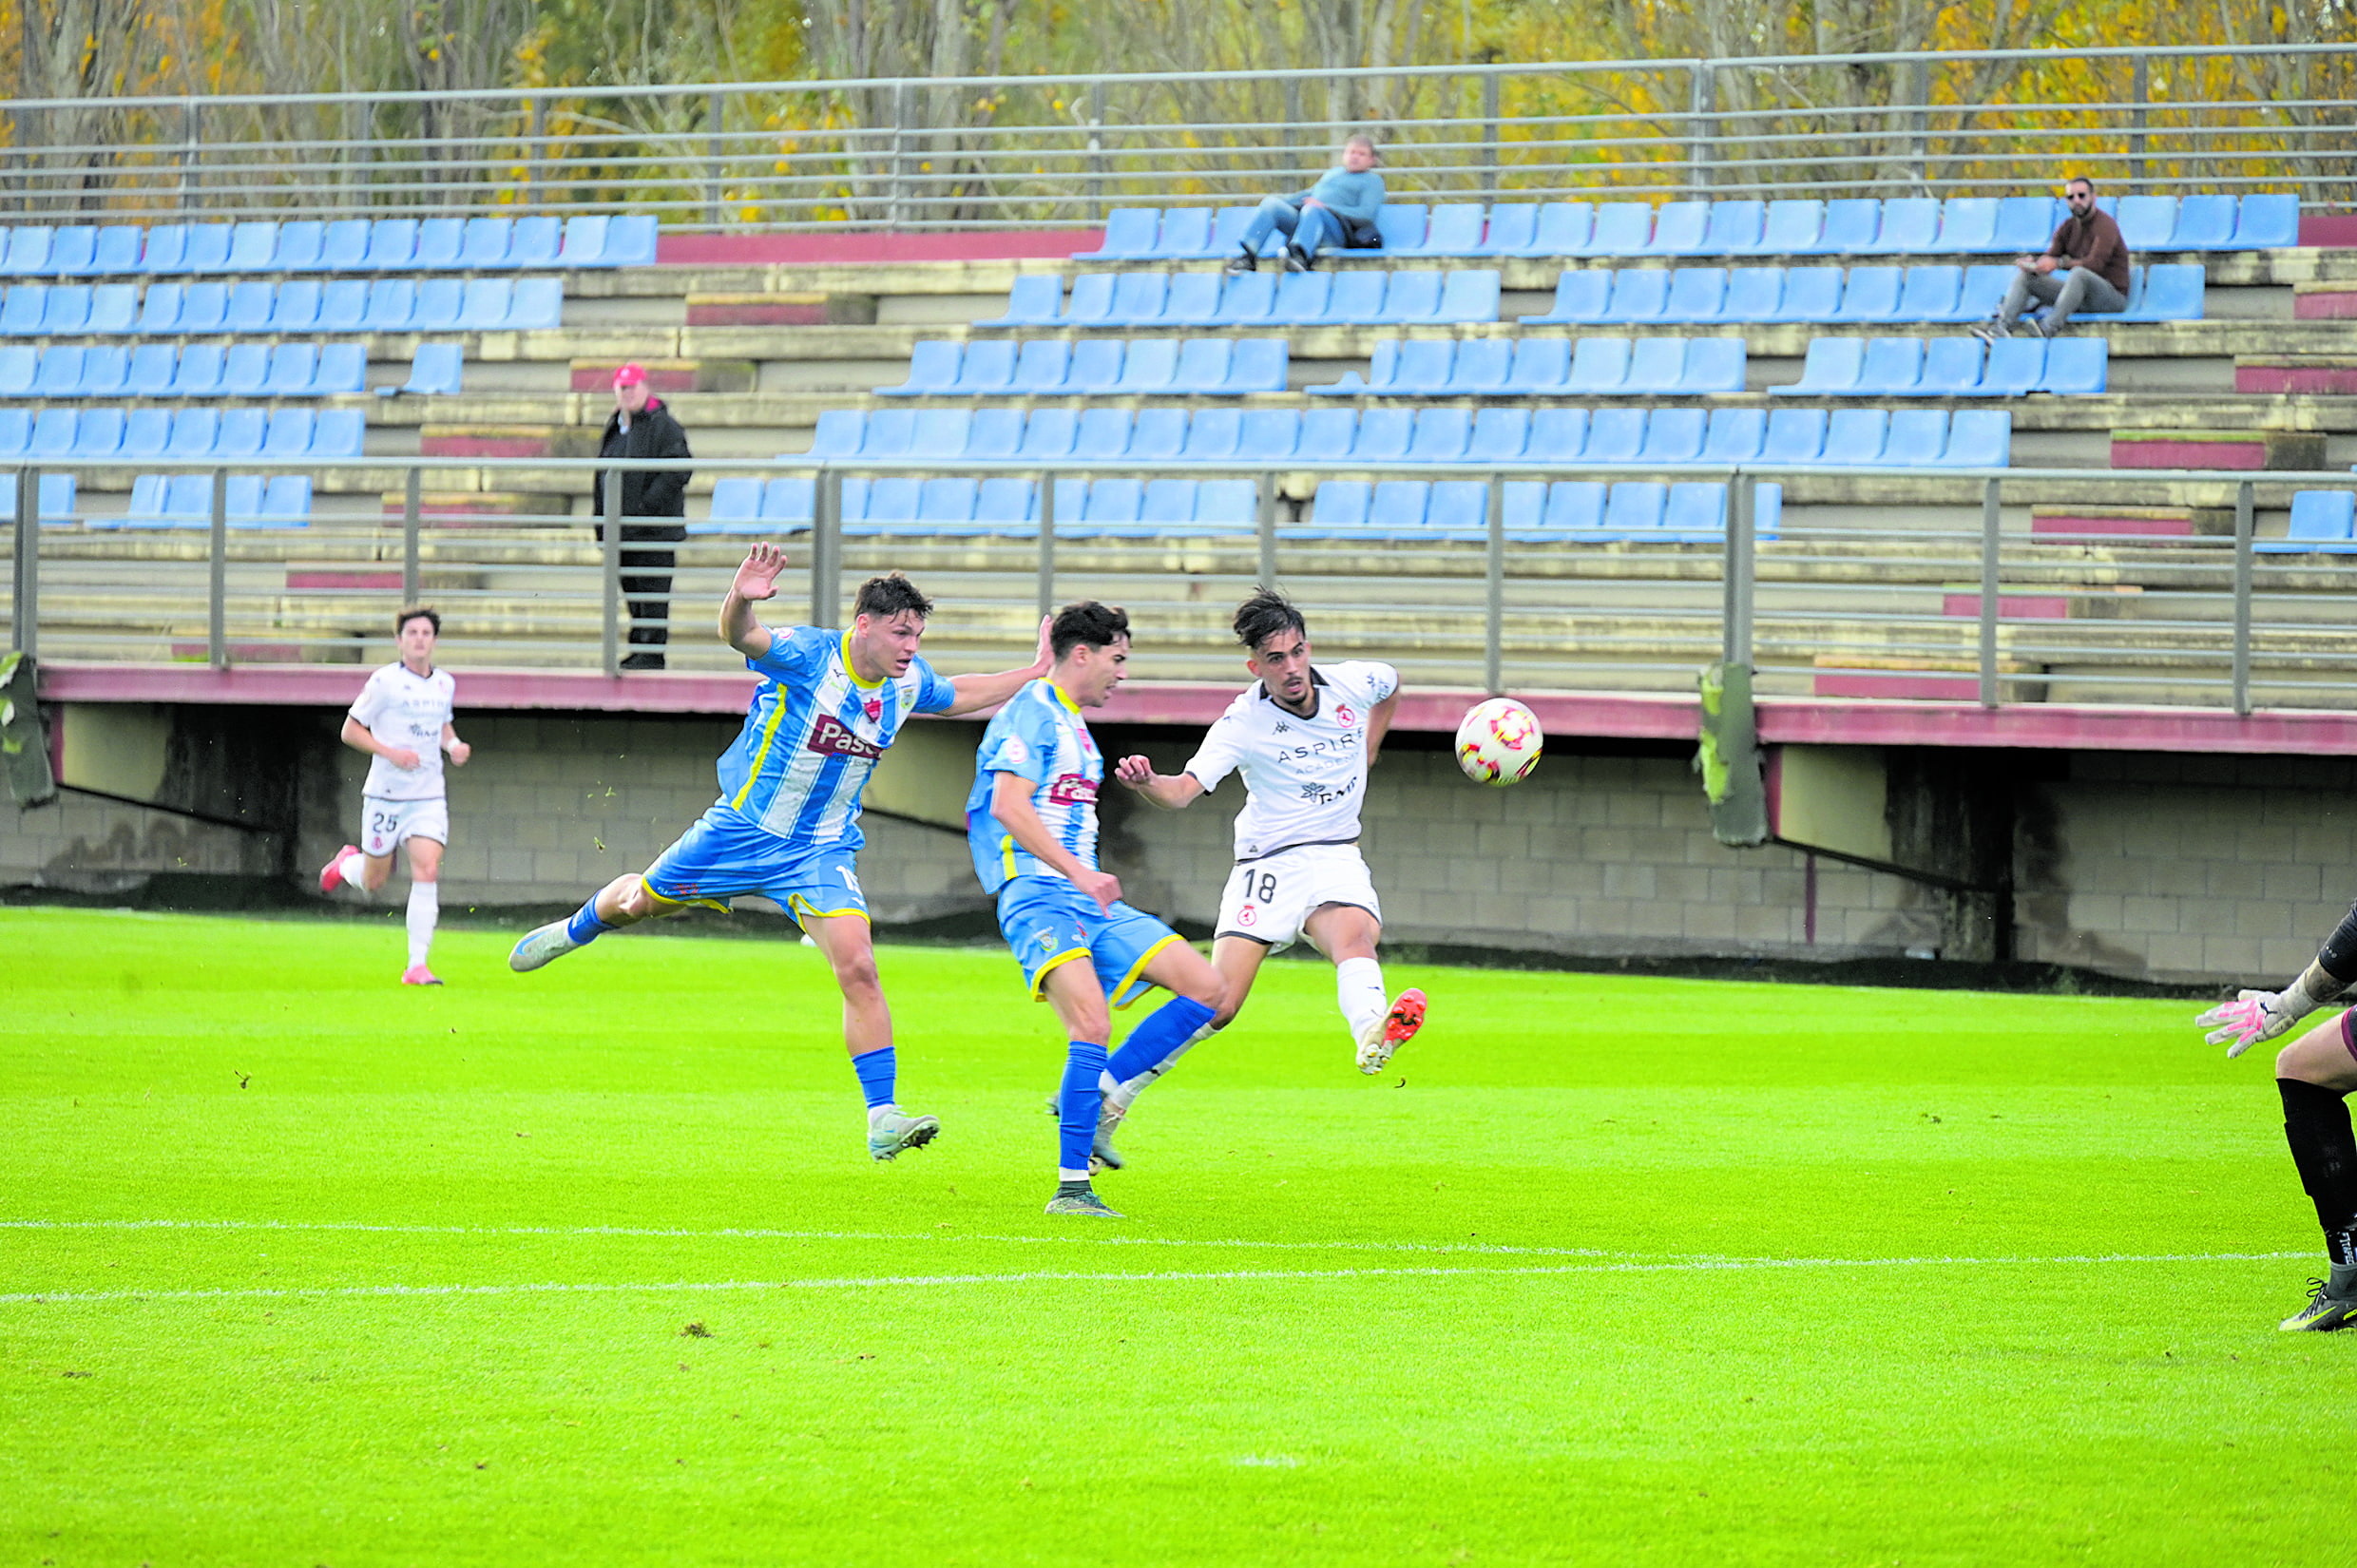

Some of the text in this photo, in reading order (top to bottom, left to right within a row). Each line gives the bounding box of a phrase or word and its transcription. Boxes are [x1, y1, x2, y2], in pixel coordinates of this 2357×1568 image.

[1295, 752, 1359, 775] ACADE
[373, 812, 398, 833] 25
[1243, 869, 1276, 904] 18
